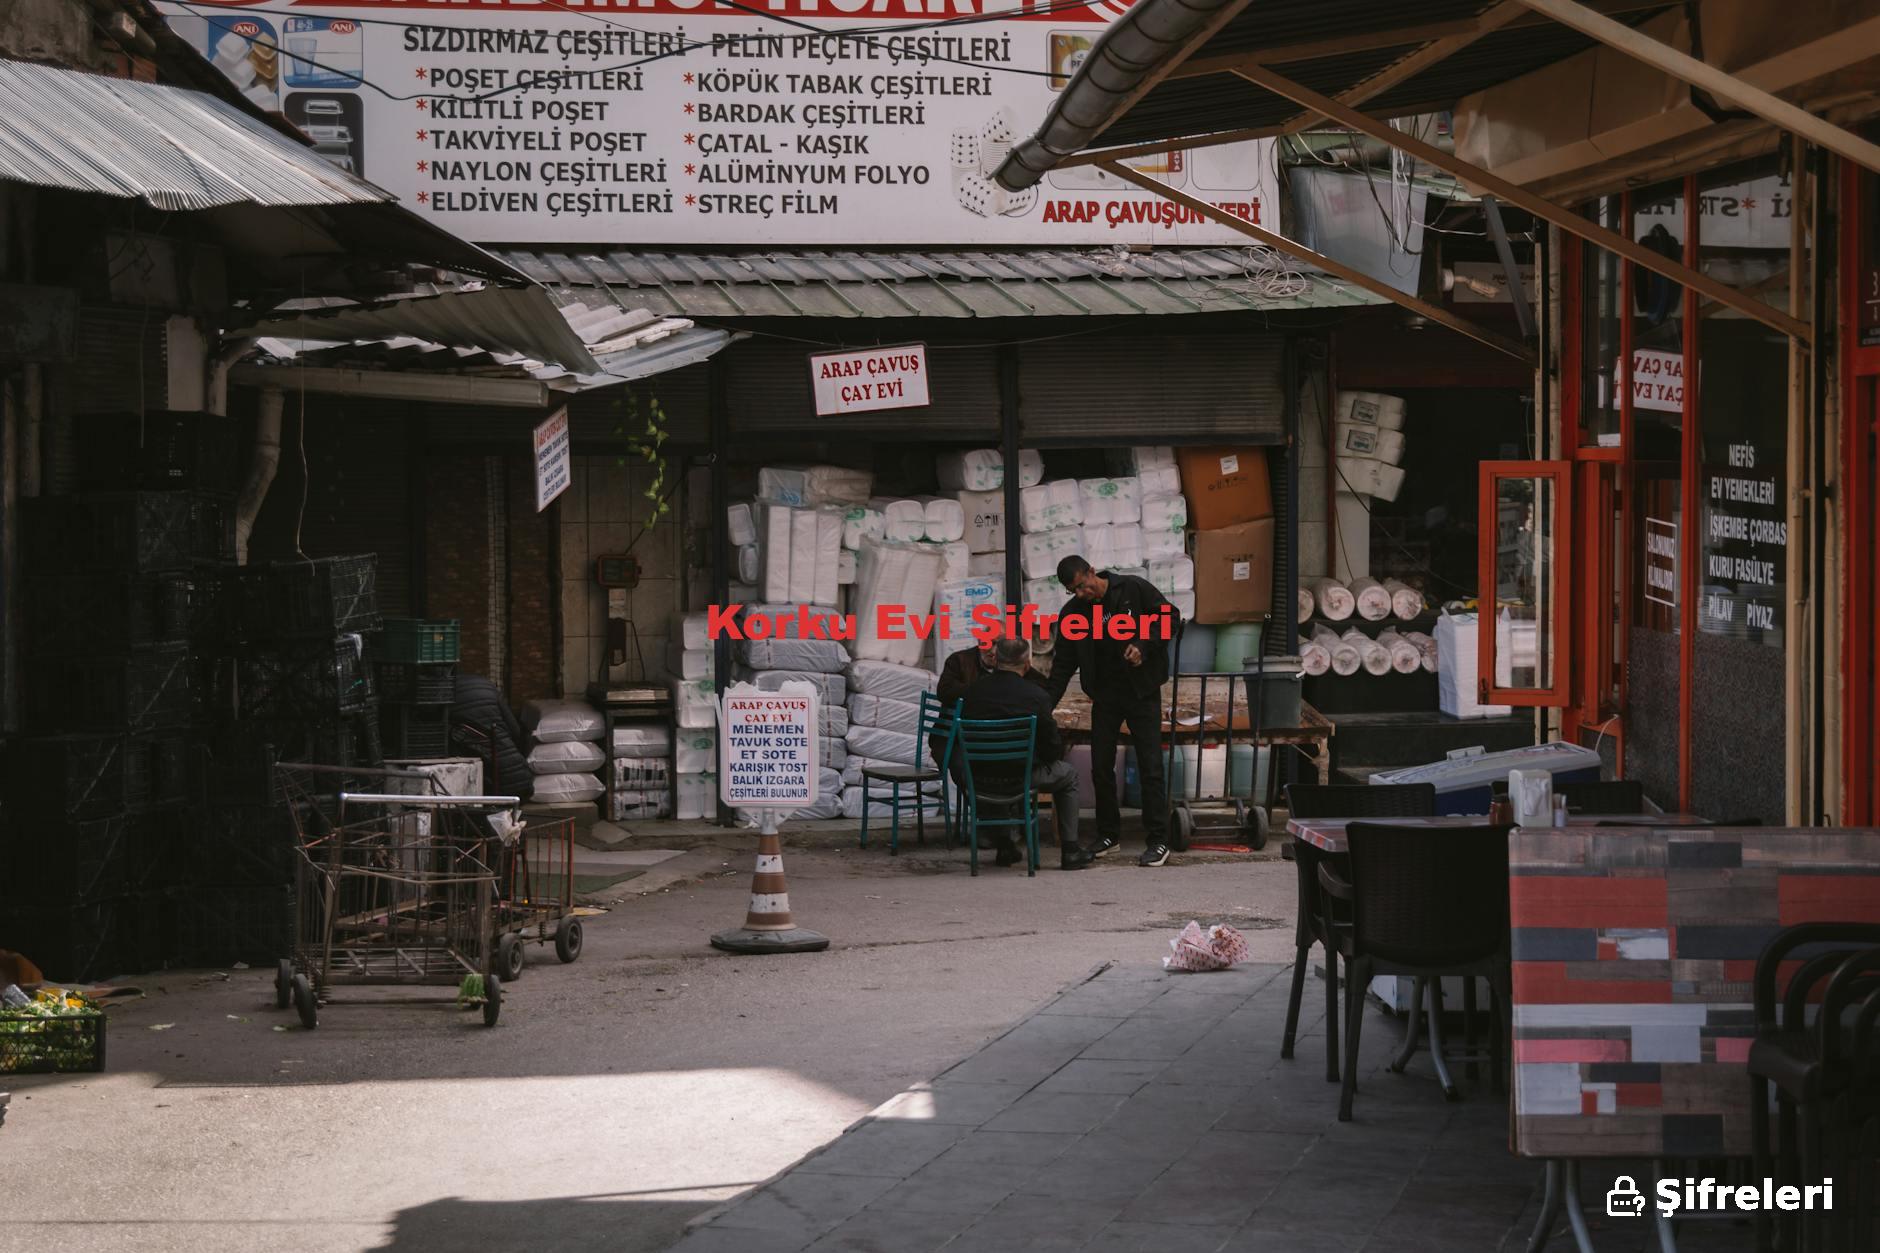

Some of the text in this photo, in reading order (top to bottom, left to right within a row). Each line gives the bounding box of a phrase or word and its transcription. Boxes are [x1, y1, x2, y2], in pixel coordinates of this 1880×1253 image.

[404, 25, 686, 60] SIZDIRMAZ ÇEŞİTLERİ
[711, 27, 1011, 67] PELİN PEÇETE ÇEŞİTLERİ
[430, 66, 643, 94] POŞET ÇEŞİTLERİ
[698, 70, 992, 100] KÖPÜK TABAK ÇEŞİTLERİ
[431, 95, 609, 124] KİLİTLİ POŞET
[698, 101, 925, 130] BARDAK ÇEŞİTLERİ
[431, 125, 647, 157] TAKVİYELİ POŞET
[698, 133, 772, 159] ÇATAL
[797, 135, 869, 159] KAŞIK
[431, 157, 667, 188] NAYLON ÇEŞİTLERİ
[698, 161, 930, 186] ALÜMİNYUM FOLYO
[431, 187, 673, 219] ELDİVEN ÇEŞİTLERİ
[698, 190, 838, 219] STREÇ FİLM
[1043, 201, 1099, 222] ARAP
[1105, 201, 1204, 229] ÇAVUŞUN
[821, 355, 919, 379] ARAP ÇAVUŞ
[841, 378, 904, 406] ÇAY EVİ
[1729, 440, 1754, 468] NEFİS
[1711, 476, 1775, 505] EV YEMEKLERİ
[1710, 511, 1787, 547] İŞKEMBE ÇORBAS
[1709, 554, 1774, 585] KURU FASÜLYE
[1708, 591, 1773, 629] PİLAV PİYAZ
[730, 702, 806, 712] ARAP ÇAVUŞ
[745, 714, 768, 724] ÇAY
[729, 737, 808, 747] TAVUK SOTE
[733, 725, 804, 734] MENEMEN
[730, 763, 808, 774] KARIŞIK TOST
[741, 750, 796, 759] ET SOTE
[730, 787, 808, 800] ÇEŞİTLERİ BULUNUR
[733, 776, 805, 785] BALIK IZGARA
